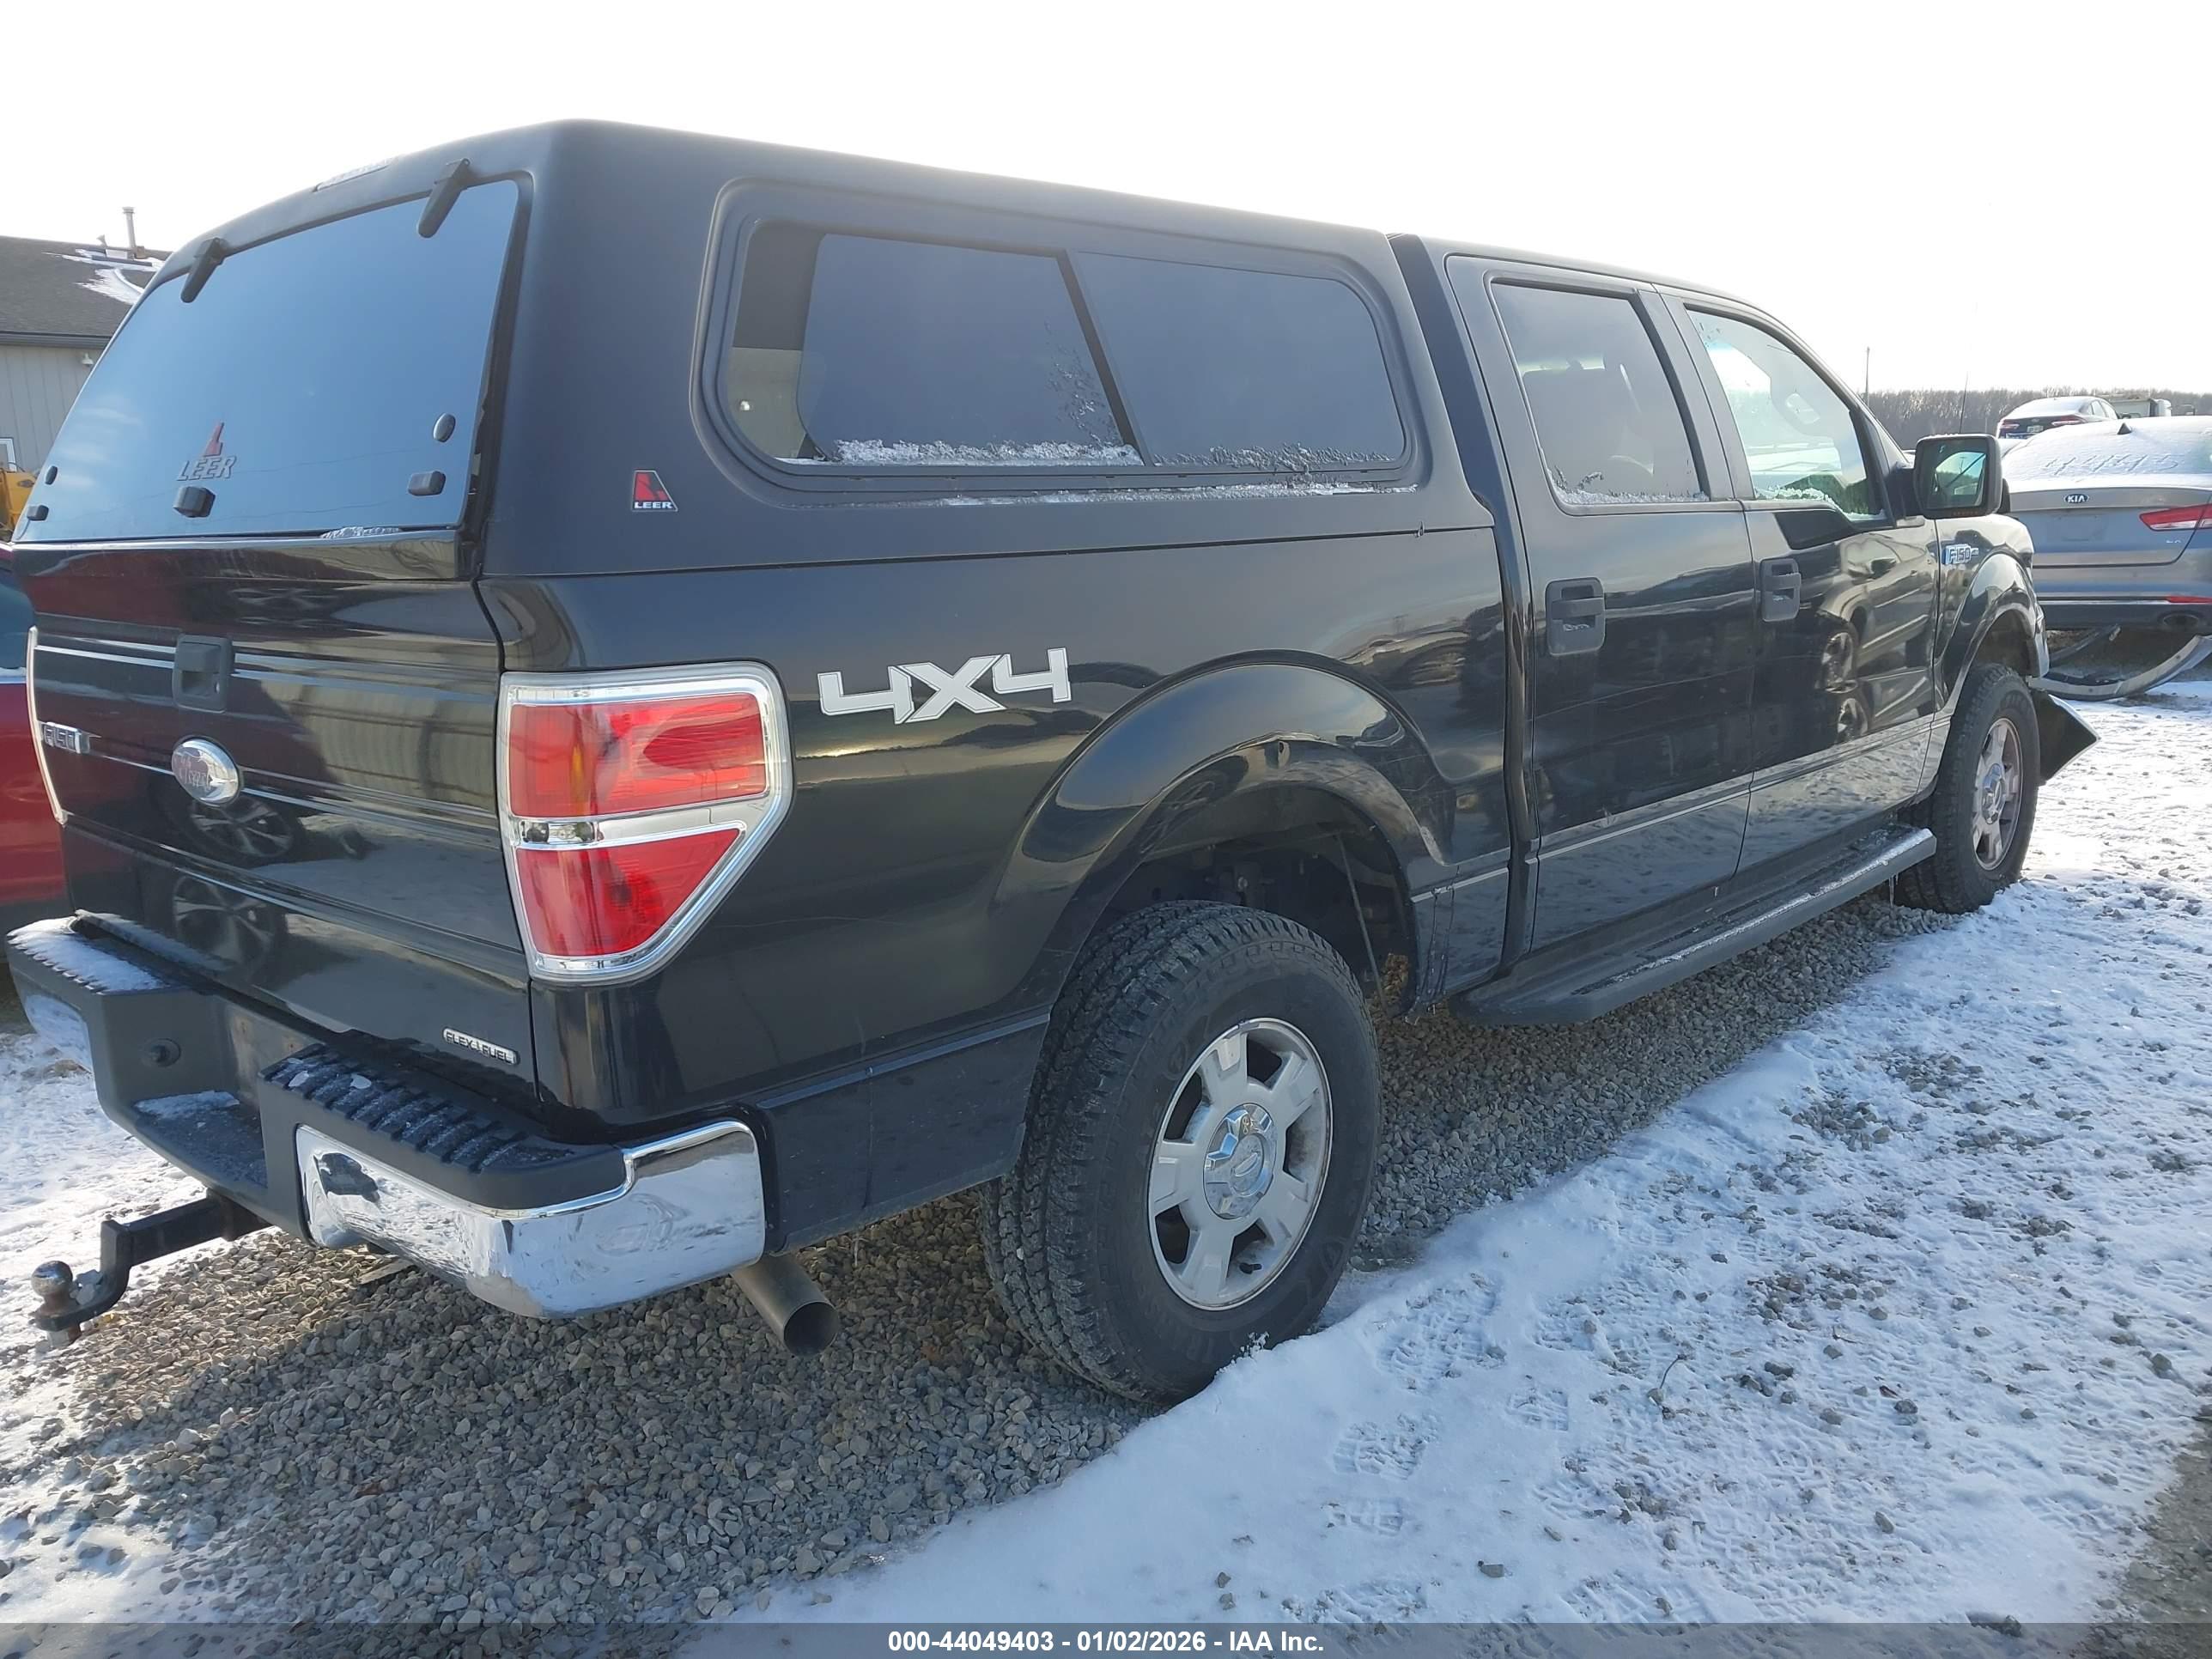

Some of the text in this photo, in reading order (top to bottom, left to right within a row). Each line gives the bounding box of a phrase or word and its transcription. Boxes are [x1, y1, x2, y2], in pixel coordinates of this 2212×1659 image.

[176, 455, 237, 481] LEER
[817, 647, 1072, 725] 4X4
[446, 1030, 514, 1064] FLEX FUEL
